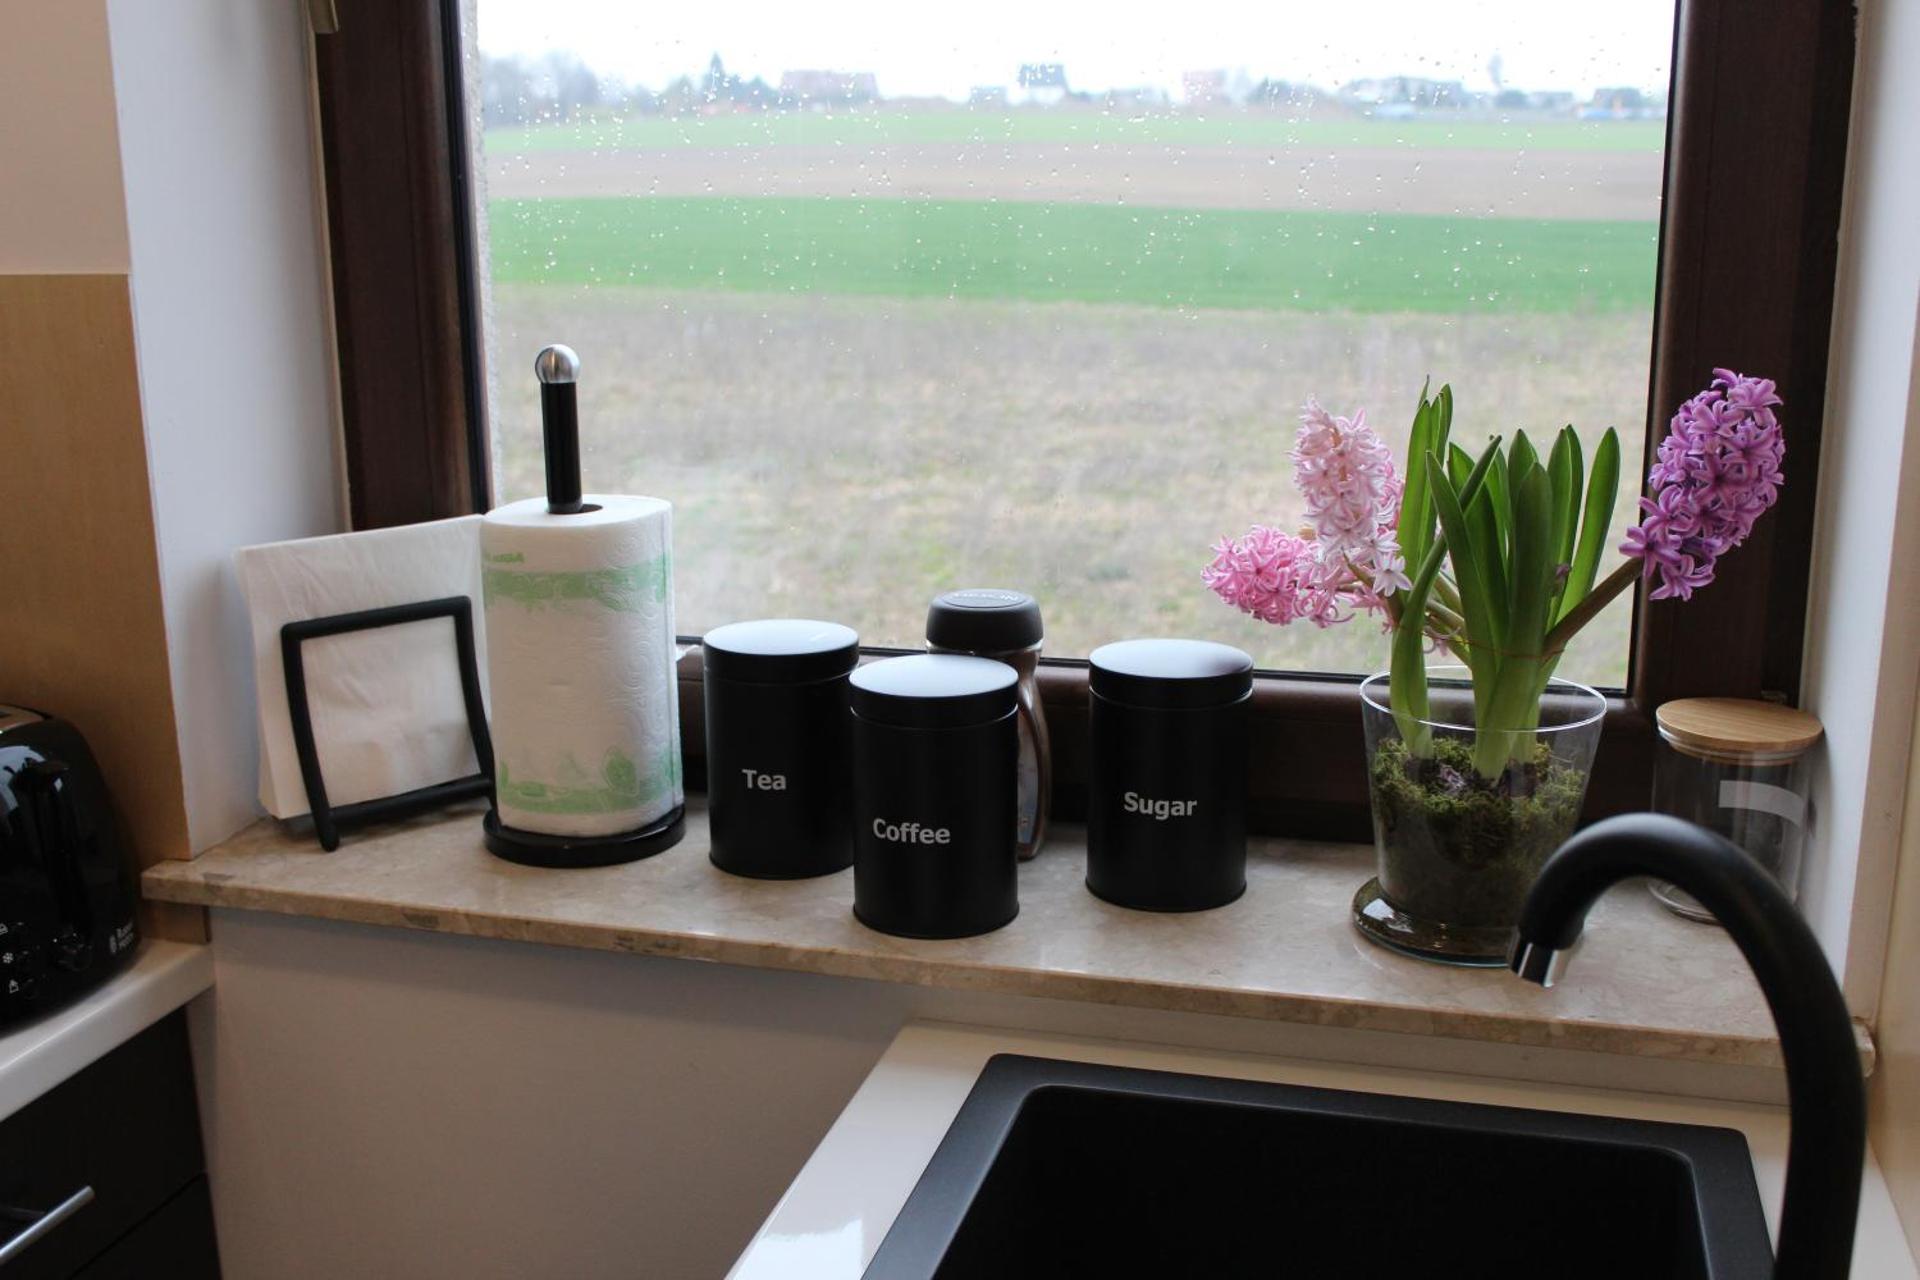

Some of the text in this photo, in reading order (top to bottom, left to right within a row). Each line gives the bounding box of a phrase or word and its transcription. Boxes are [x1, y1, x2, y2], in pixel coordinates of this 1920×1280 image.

[742, 768, 786, 791] Tea
[1123, 790, 1197, 820] Sugar
[873, 817, 951, 845] Coffee
